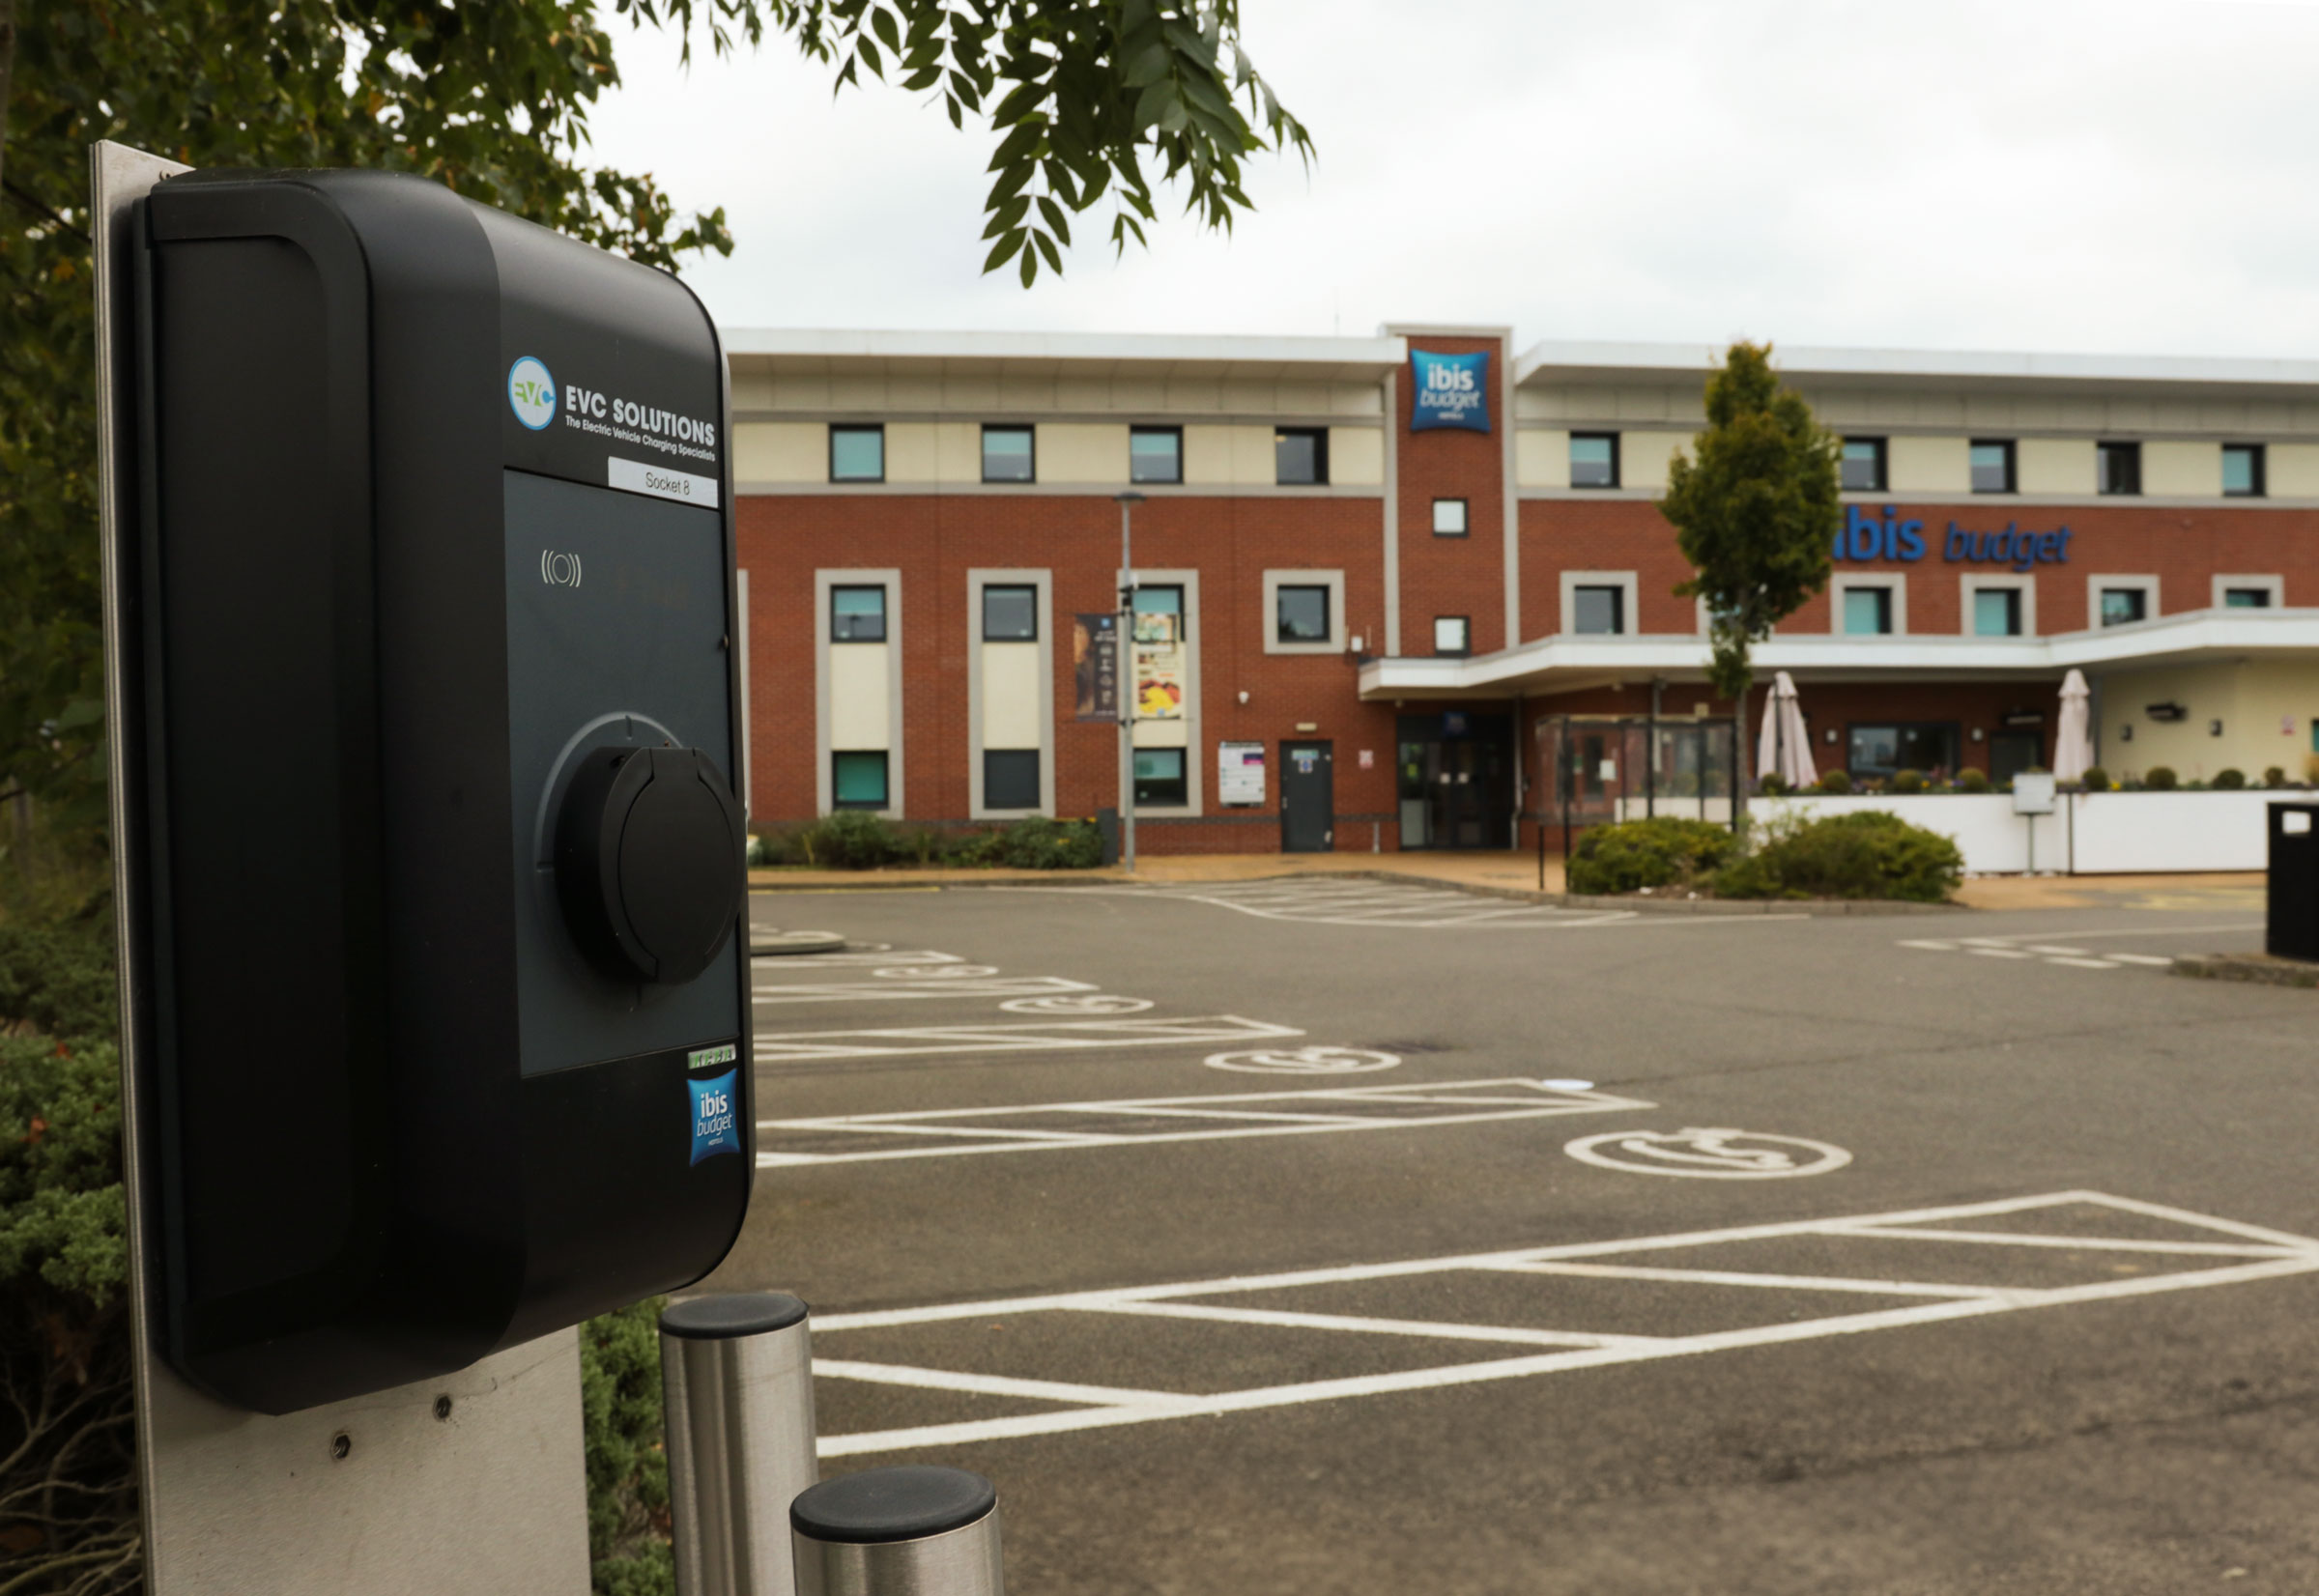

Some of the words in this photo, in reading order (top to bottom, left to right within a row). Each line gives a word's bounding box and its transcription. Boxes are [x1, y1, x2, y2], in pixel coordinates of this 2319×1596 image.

[1428, 363, 1474, 391] ibis
[1419, 388, 1480, 412] budget
[566, 385, 607, 418] EVC
[613, 398, 715, 446] SOLUTIONS
[565, 414, 582, 428] The
[582, 418, 613, 437] Electric
[613, 427, 642, 443] Vehicle
[642, 434, 677, 455] Charging
[678, 442, 716, 462] Specialists
[645, 471, 681, 494] Socket
[683, 480, 691, 496] 8
[1944, 520, 2072, 572] budget
[701, 1090, 728, 1119] ibis
[697, 1113, 732, 1137] budget
